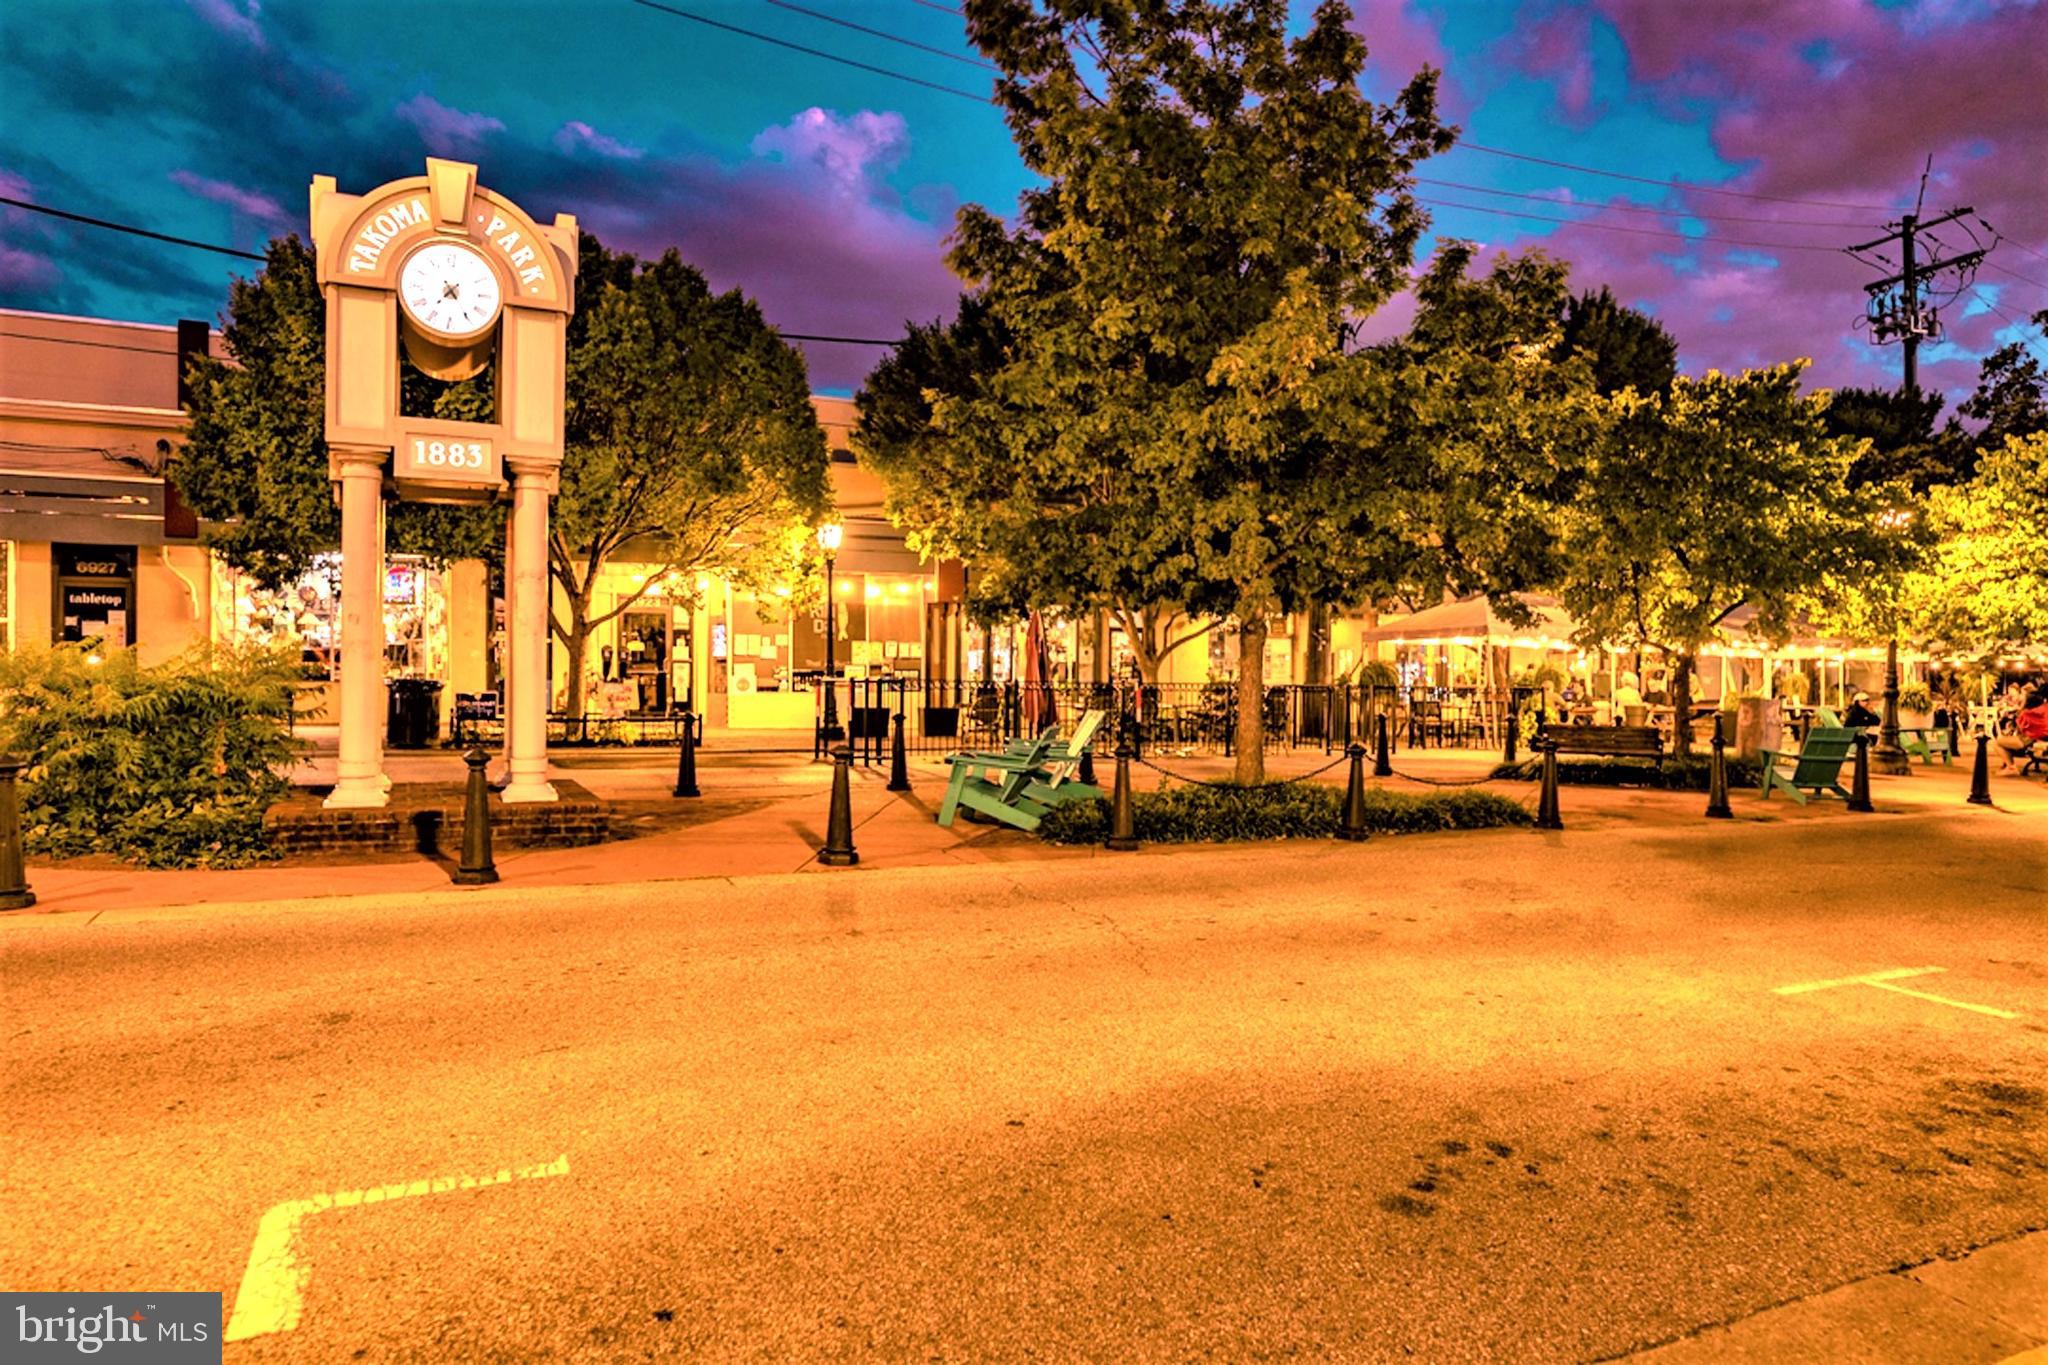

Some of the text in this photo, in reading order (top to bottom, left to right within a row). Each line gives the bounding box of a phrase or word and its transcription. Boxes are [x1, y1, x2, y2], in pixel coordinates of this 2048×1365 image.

[350, 199, 547, 285] TAKOMA PARK
[415, 440, 483, 469] 1883
[76, 561, 117, 574] 6927
[69, 592, 122, 607] tabletop
